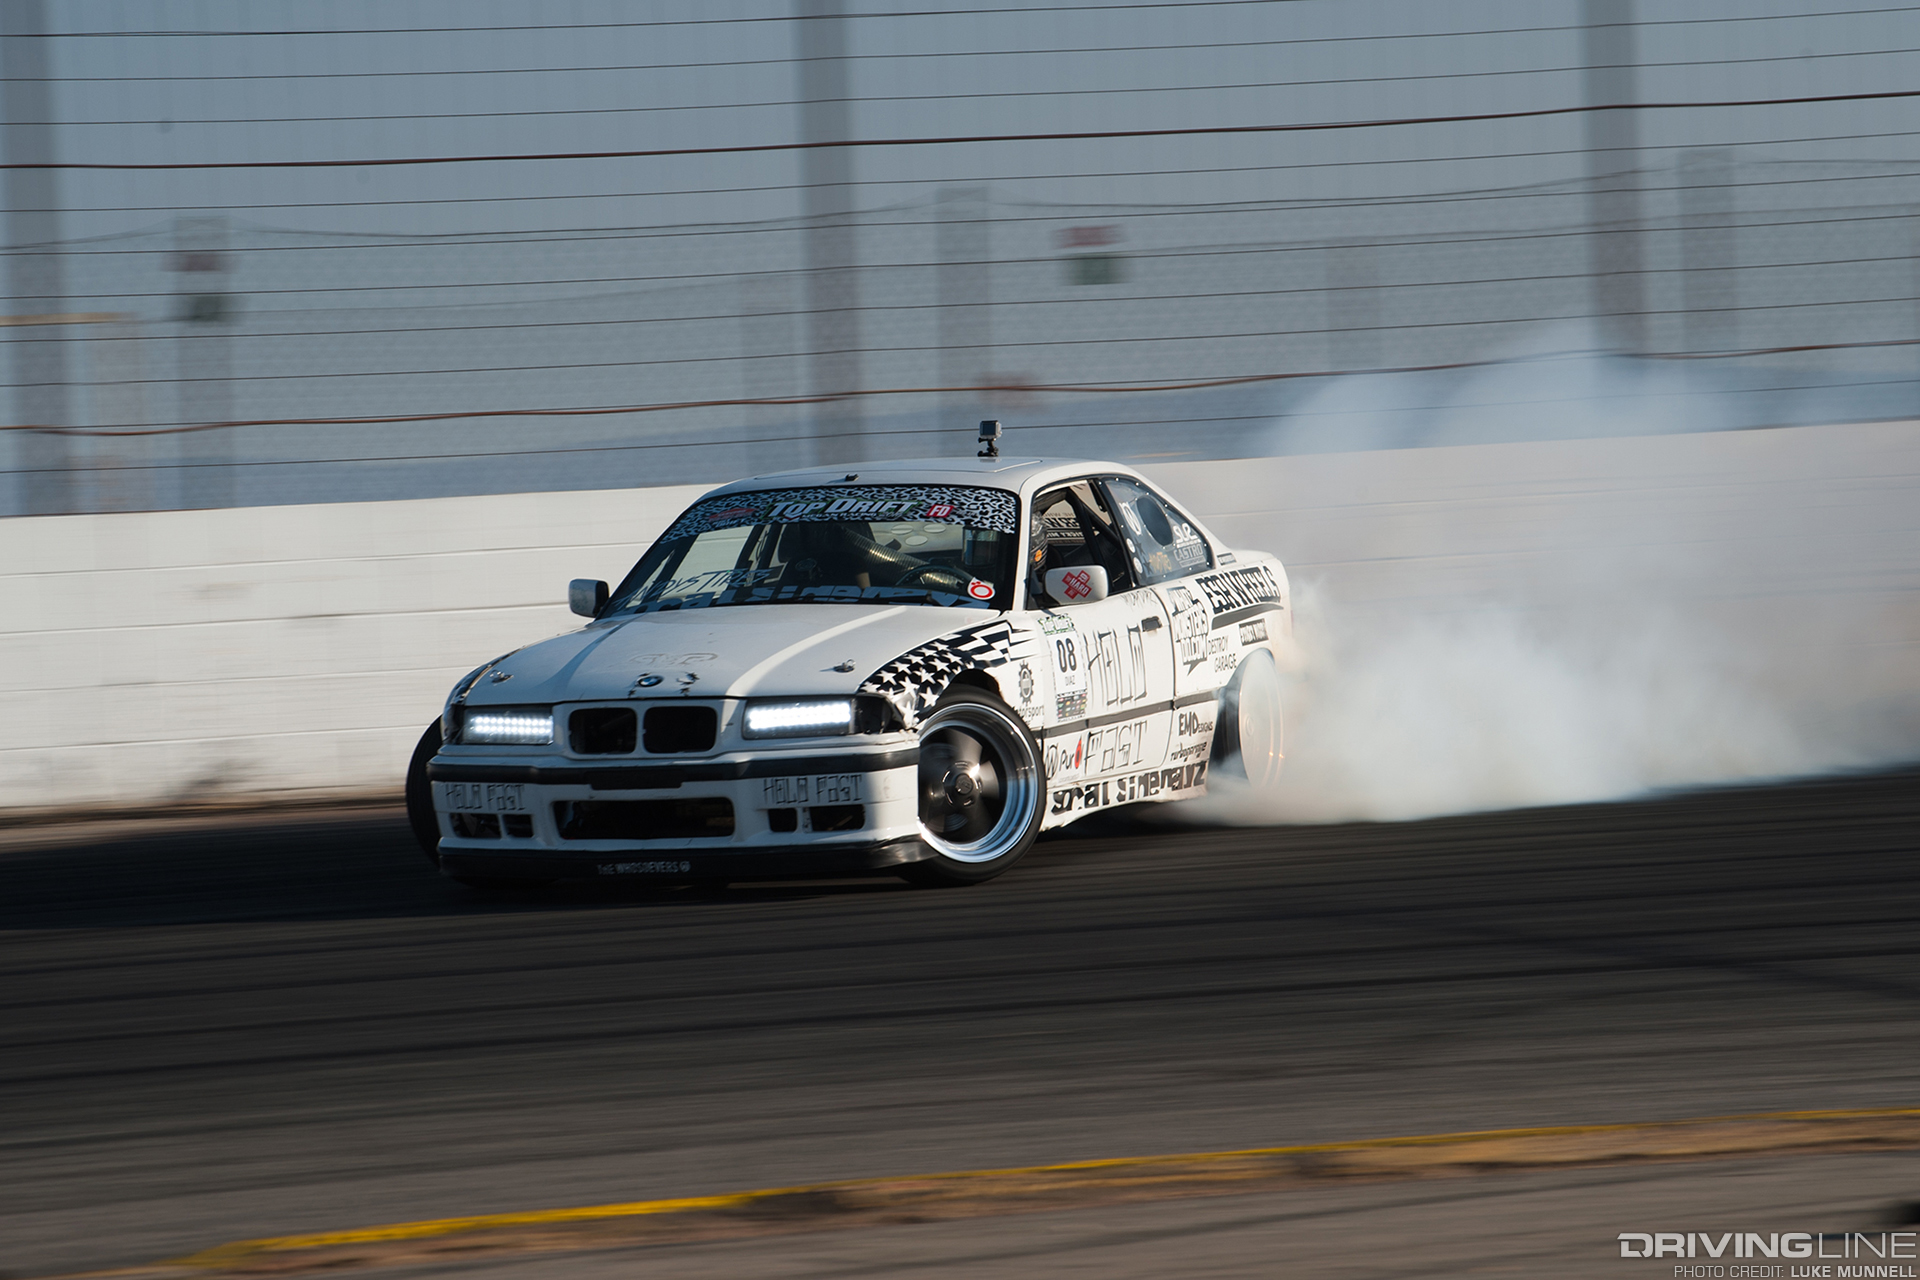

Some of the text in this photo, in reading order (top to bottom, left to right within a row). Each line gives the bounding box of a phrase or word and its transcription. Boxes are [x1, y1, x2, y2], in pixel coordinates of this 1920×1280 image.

[768, 501, 827, 519] TOP
[824, 498, 917, 514] DRIFT
[1173, 544, 1204, 562] CASTRO
[1056, 638, 1077, 673] 08
